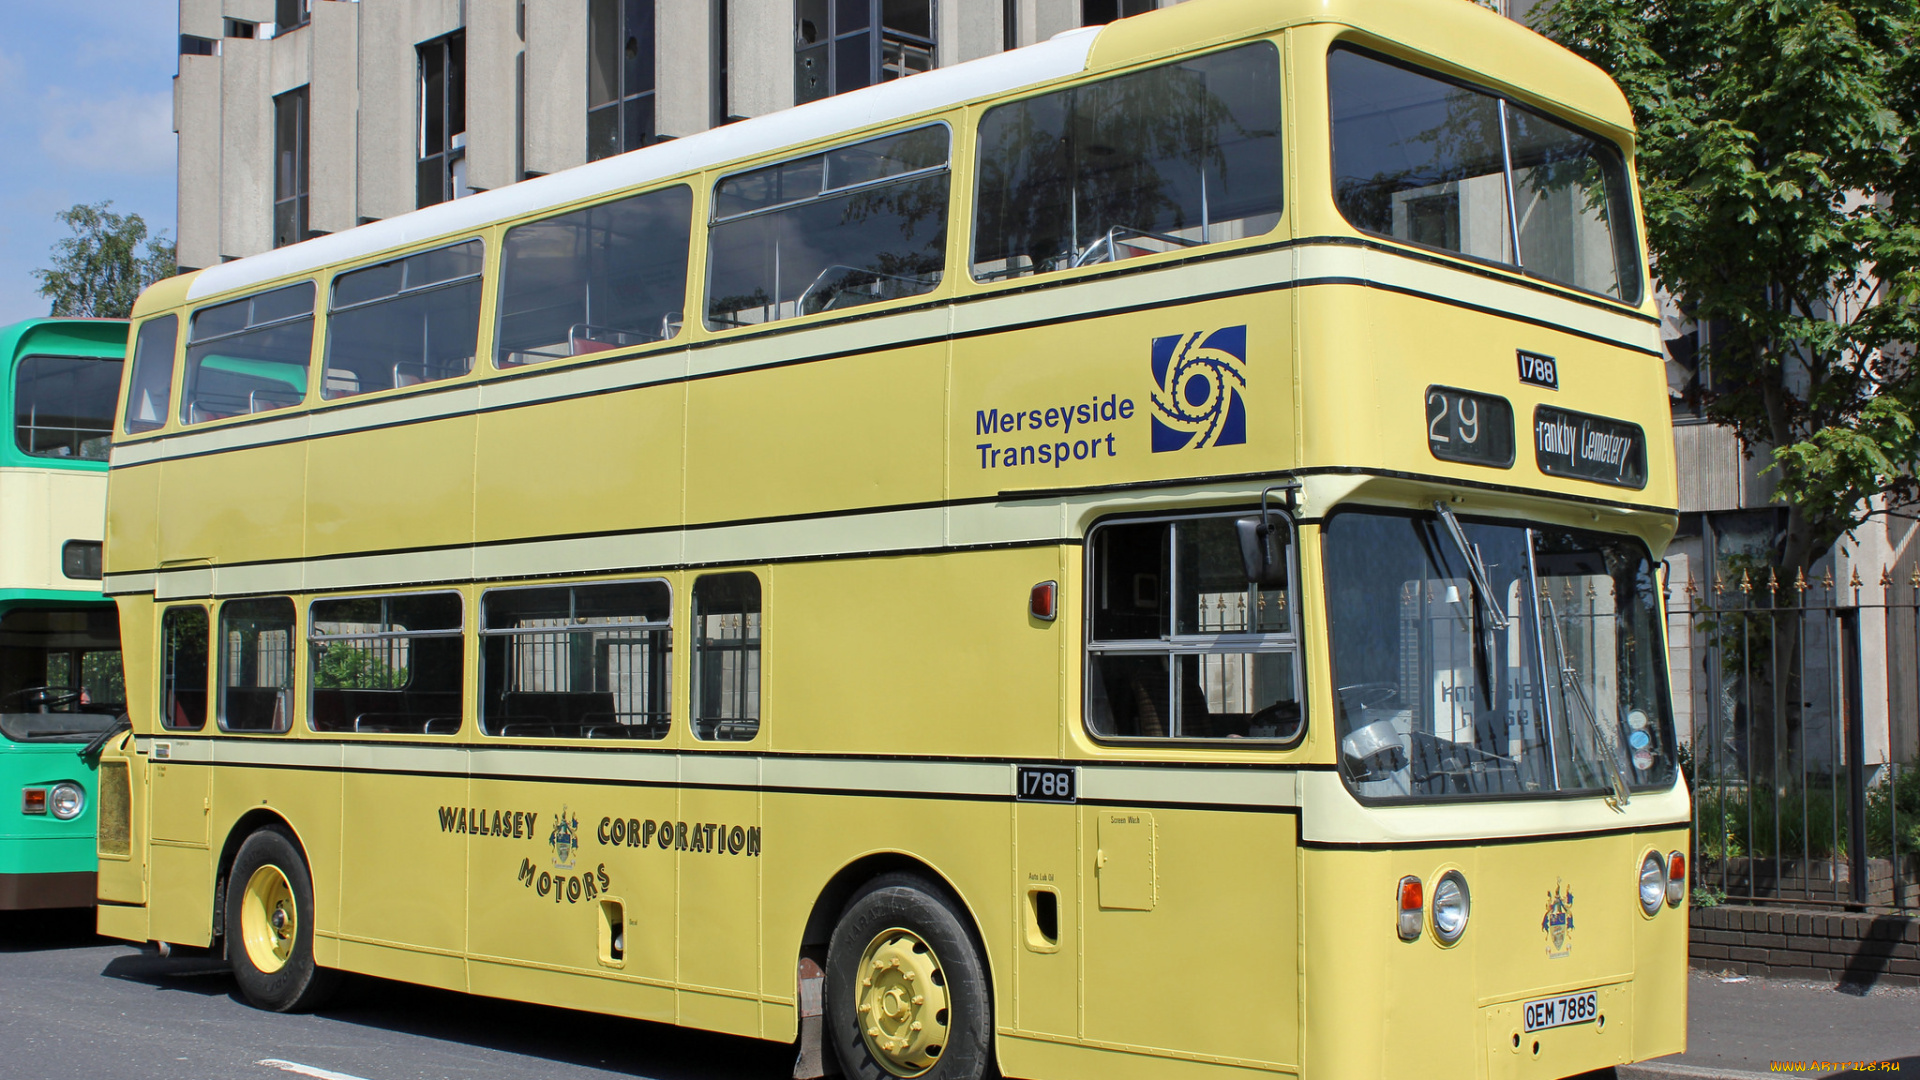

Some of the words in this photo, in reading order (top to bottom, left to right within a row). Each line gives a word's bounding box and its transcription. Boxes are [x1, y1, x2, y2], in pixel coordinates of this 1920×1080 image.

[1520, 354, 1554, 383] 1788
[975, 394, 1135, 436] Merseyside
[1428, 392, 1479, 443] 29
[976, 432, 1117, 469] Transport
[1535, 413, 1578, 467] rankby
[1580, 419, 1632, 477] Cemetery
[1023, 771, 1070, 797] 1788
[438, 806, 538, 839] WALLASEY
[597, 816, 762, 857] CORPORATION
[518, 857, 610, 904] MOTORS
[1526, 1001, 1555, 1029] OEM
[1558, 994, 1597, 1022] 788S
